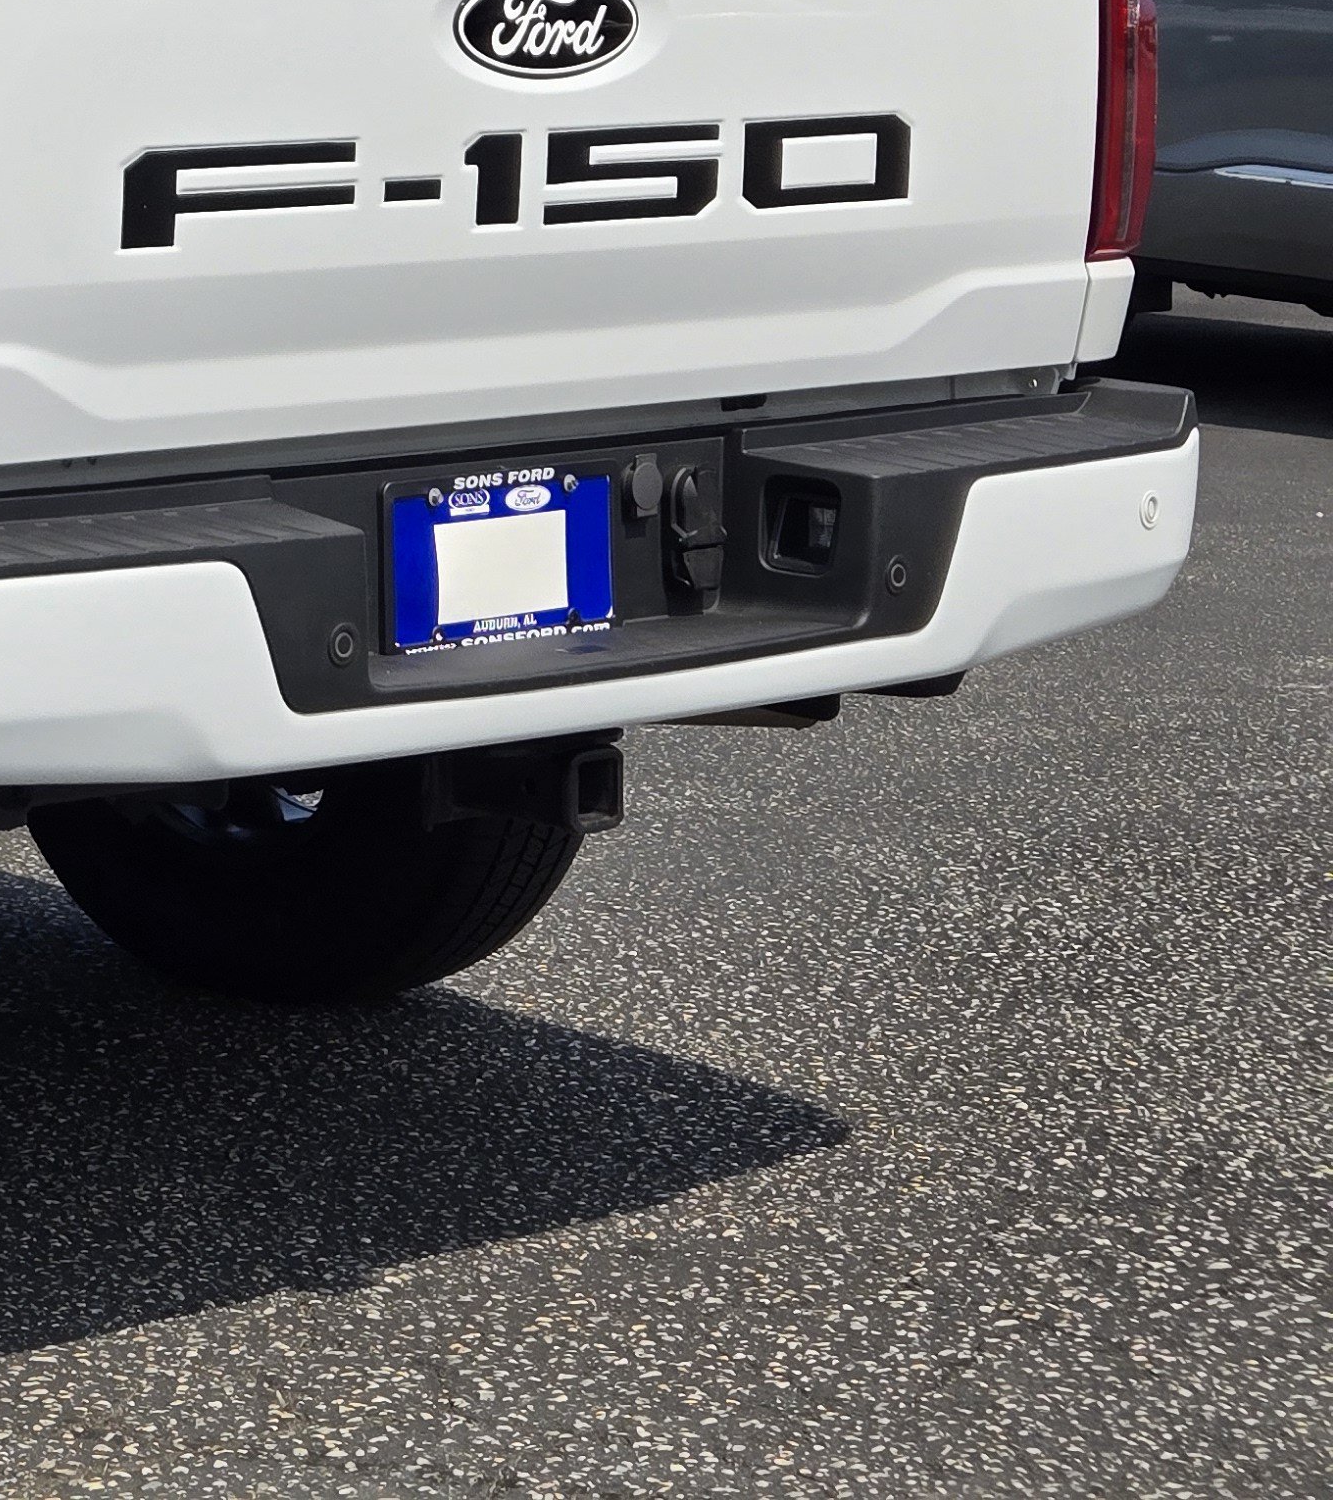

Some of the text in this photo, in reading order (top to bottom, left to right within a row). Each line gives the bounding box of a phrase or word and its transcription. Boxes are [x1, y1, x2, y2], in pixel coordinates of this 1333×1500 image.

[120, 114, 911, 250] F-150
[453, 467, 555, 490] SONS FORD
[452, 490, 484, 507] SONS
[514, 489, 542, 506] Ford
